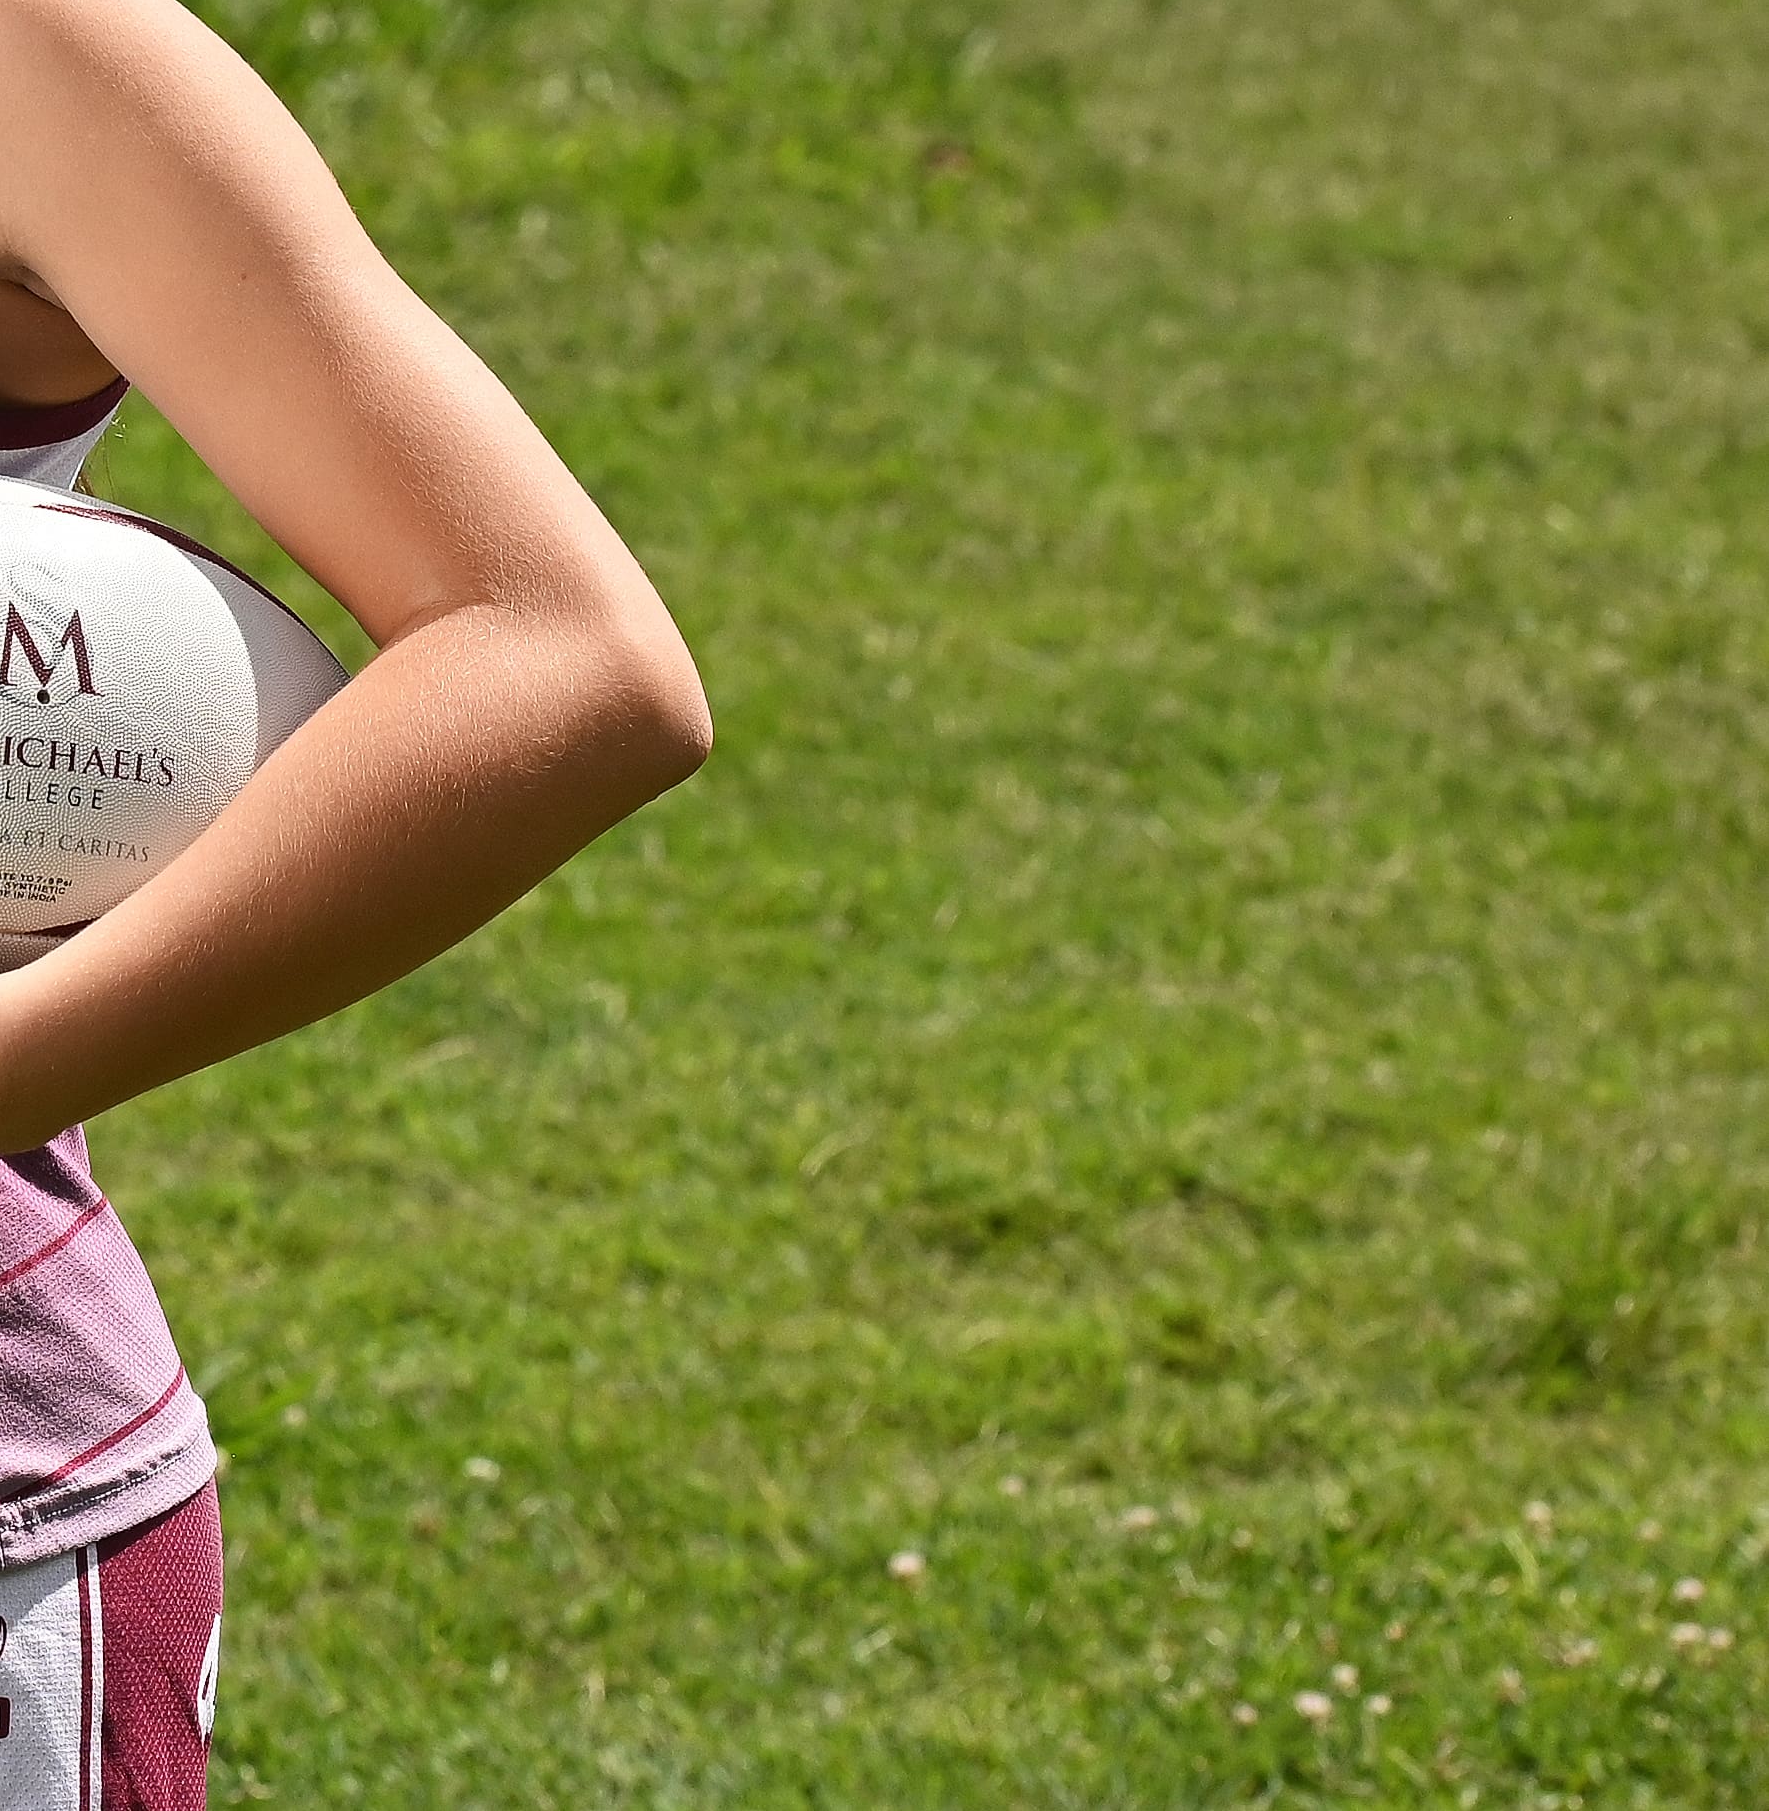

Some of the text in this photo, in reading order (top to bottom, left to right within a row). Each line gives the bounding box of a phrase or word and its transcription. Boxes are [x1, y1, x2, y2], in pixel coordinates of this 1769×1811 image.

[58, 834, 150, 863] CARITAS
[4, 881, 67, 895] SYNTHETIC
[13, 890, 25, 899] IN
